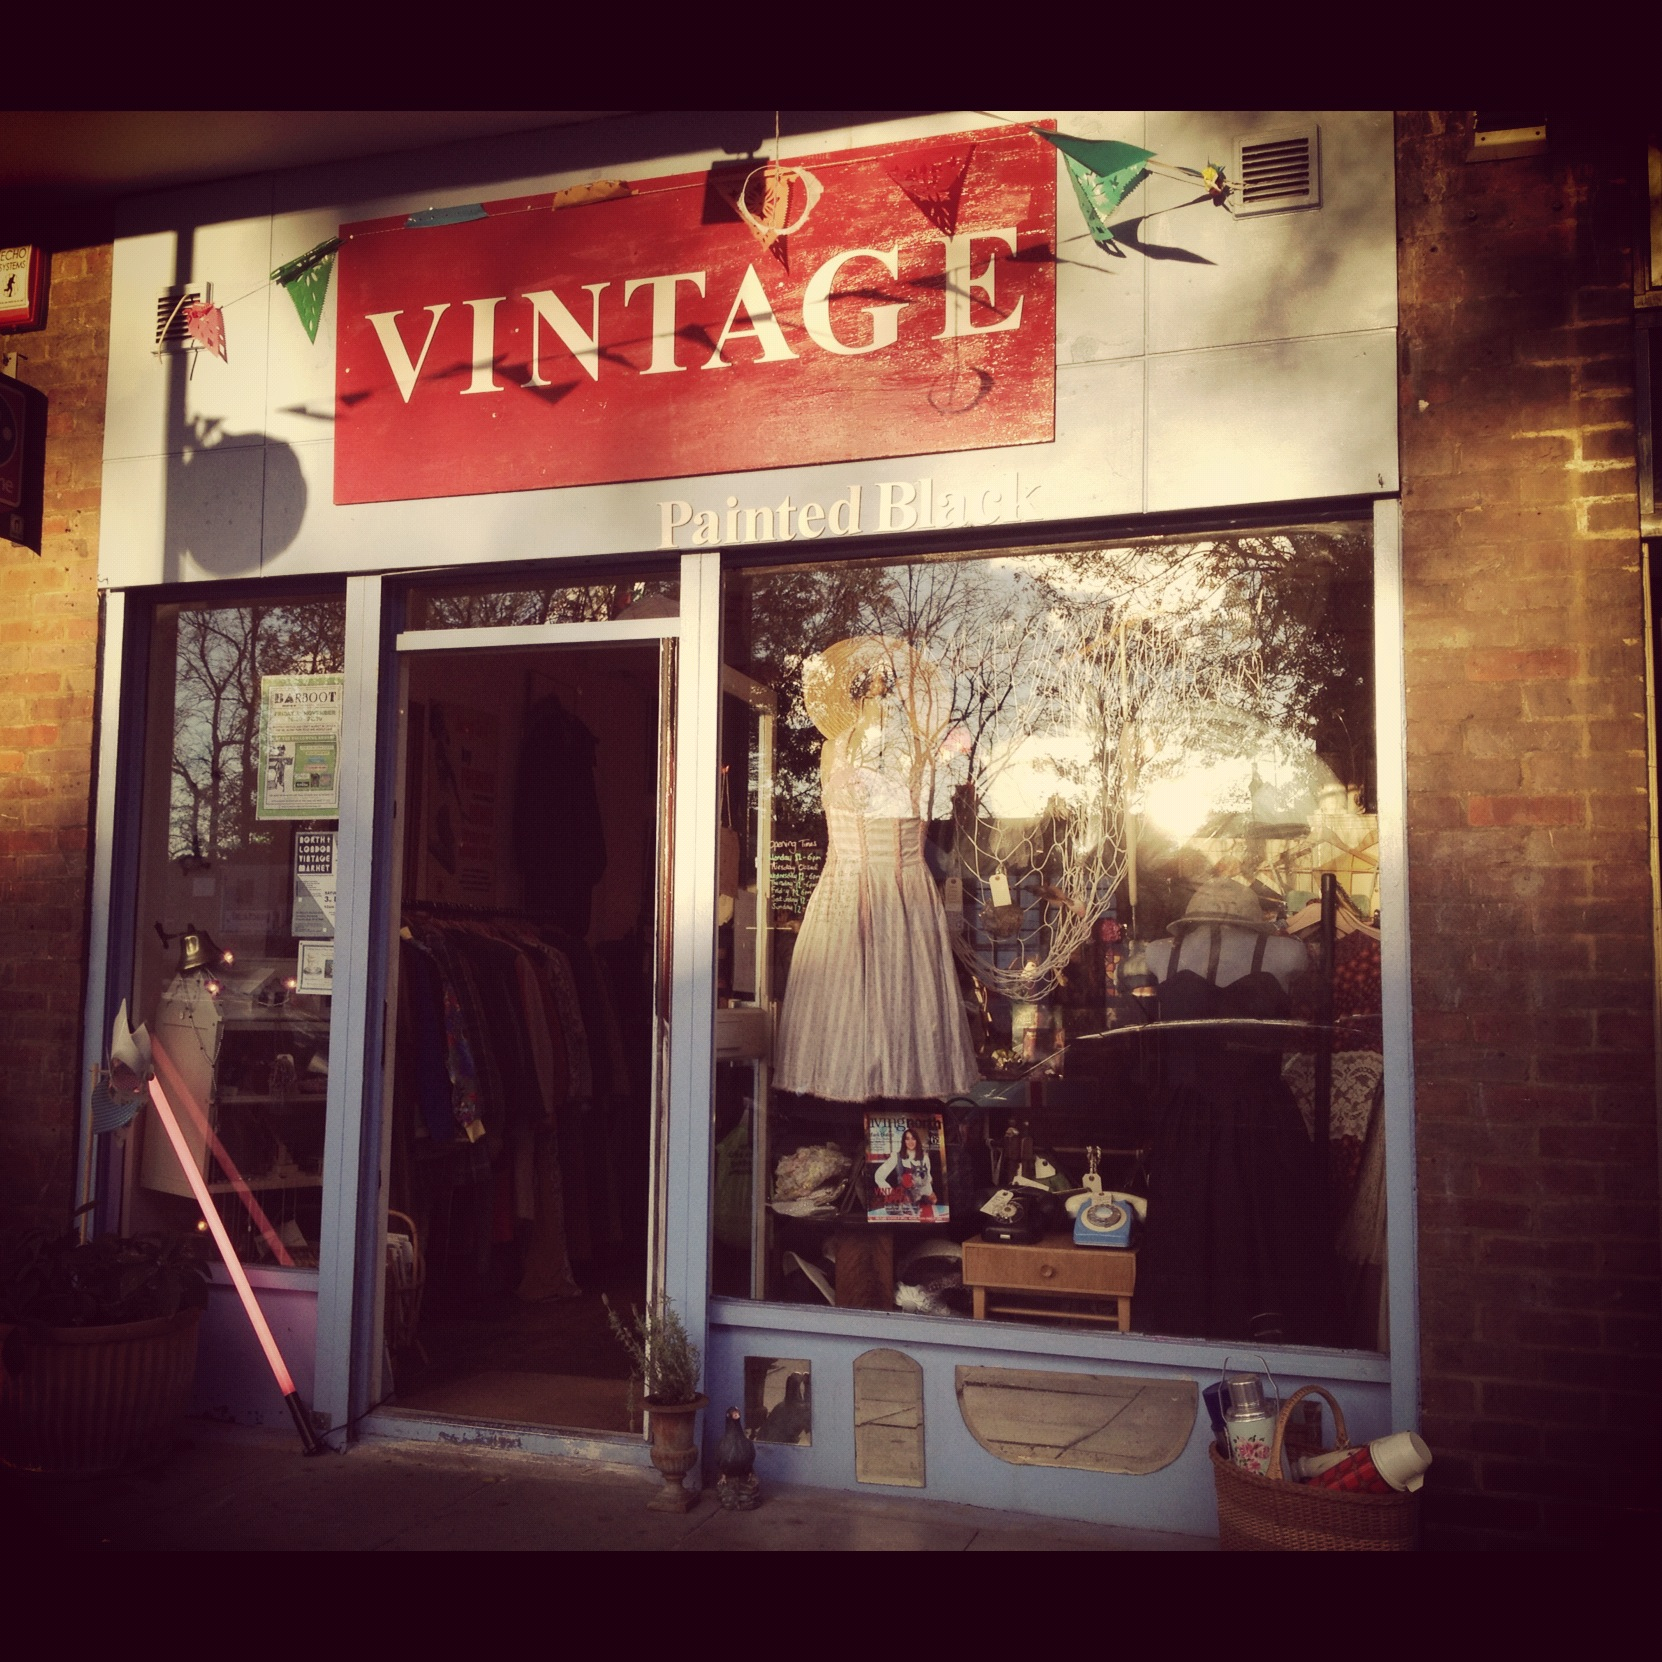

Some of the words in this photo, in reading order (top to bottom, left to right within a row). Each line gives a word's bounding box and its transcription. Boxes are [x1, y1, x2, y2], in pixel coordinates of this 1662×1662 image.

[0, 248, 27, 261] ECHO
[0, 260, 26, 272] SYSTEMS
[364, 226, 1025, 405] VINTAGE
[657, 485, 863, 551] Painted
[874, 472, 1044, 534] Black
[299, 836, 325, 844] NORTH
[299, 845, 331, 853] LONDON
[299, 855, 331, 863] VINTAGE
[298, 864, 330, 872] MARKET
